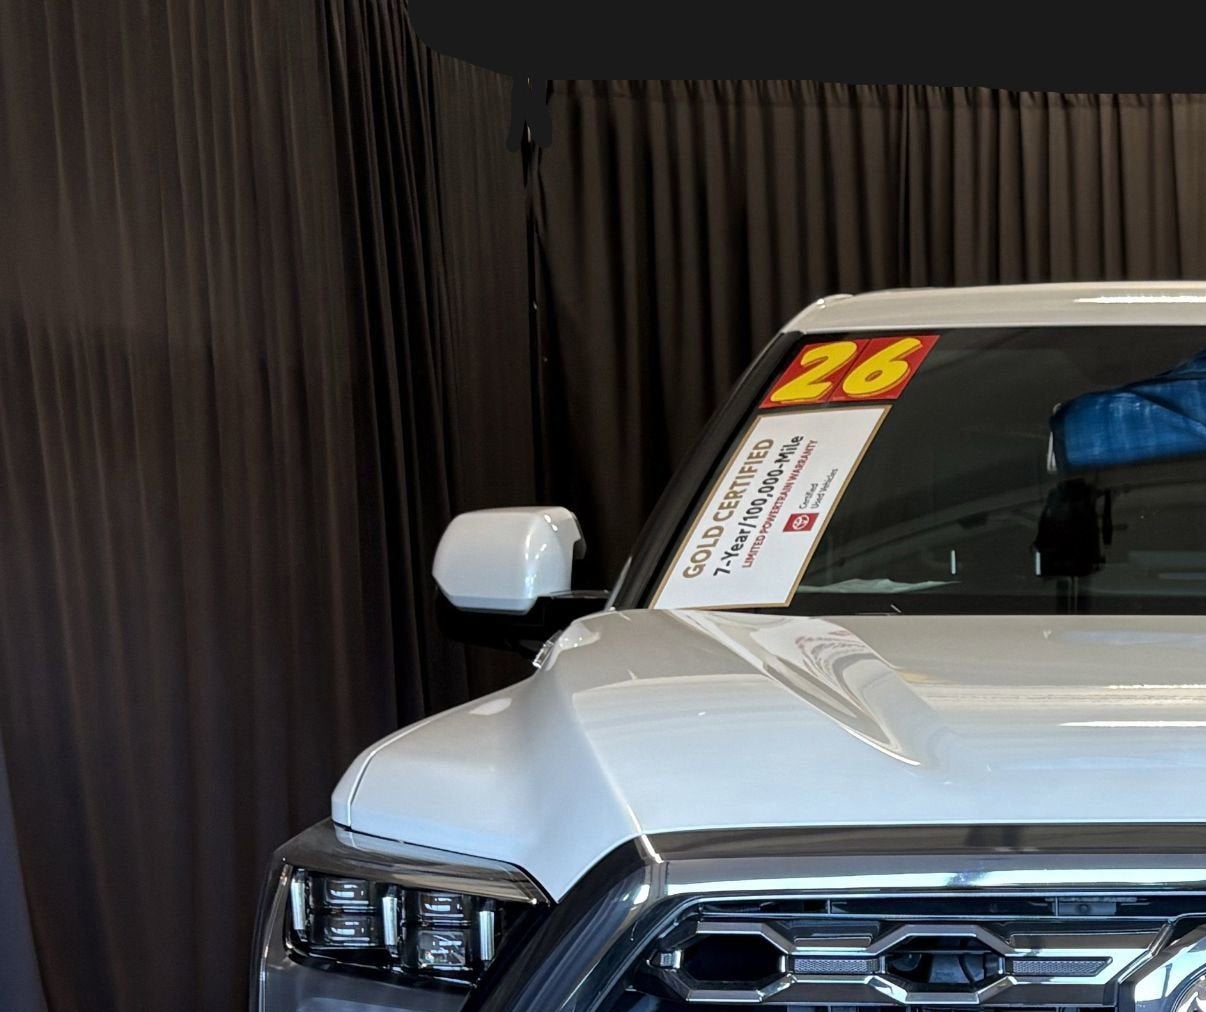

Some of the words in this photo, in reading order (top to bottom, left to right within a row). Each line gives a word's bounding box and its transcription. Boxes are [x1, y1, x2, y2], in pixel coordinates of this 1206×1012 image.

[770, 337, 923, 403] 26
[682, 525, 725, 579] GOLD
[712, 438, 774, 522] CERTIFIED
[712, 435, 804, 576] 7-Year/100,000-Mile
[741, 534, 766, 569] LIMITED
[759, 479, 795, 534] POWERTRAIN
[788, 439, 818, 481] WARRANTY
[798, 483, 819, 510] Certified
[810, 492, 825, 509] Used
[819, 468, 839, 492] Vehicles
